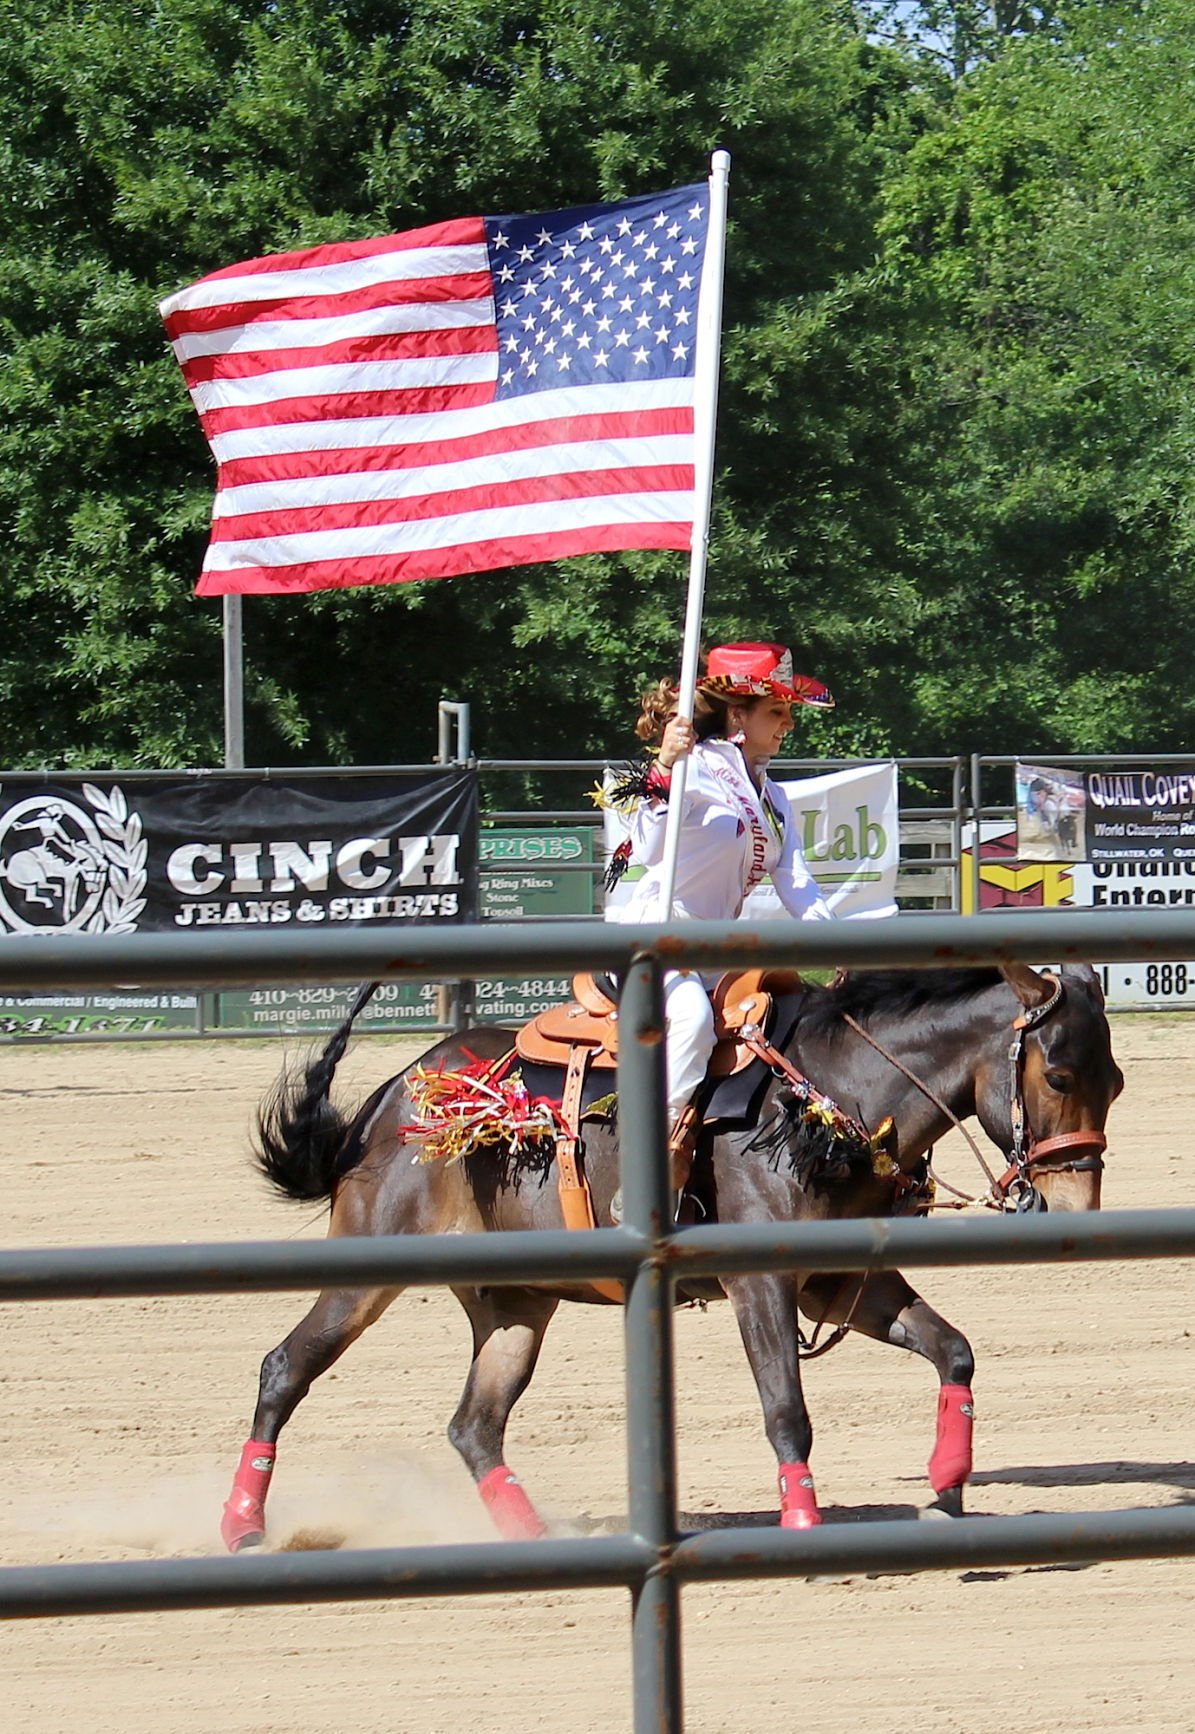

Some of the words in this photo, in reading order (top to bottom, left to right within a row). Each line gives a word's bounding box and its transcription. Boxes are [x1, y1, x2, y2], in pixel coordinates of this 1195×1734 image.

[1088, 773, 1141, 809] QUAIL
[1152, 810, 1181, 822] Home
[1182, 810, 1194, 821] of
[801, 805, 888, 862] Lab
[1094, 823, 1125, 837] World
[1126, 823, 1179, 839] Champion
[166, 834, 460, 896] CINCH
[491, 878, 519, 890] Ring
[520, 877, 554, 889] Mixes
[486, 892, 520, 903] Stone
[175, 899, 292, 926] JEANS
[296, 897, 325, 922] &
[328, 893, 460, 921] SHIRTS
[481, 905, 525, 917] Topsoil
[17, 996, 85, 1008] Commercial
[93, 996, 158, 1010] Engineered
[160, 995, 170, 1008] &
